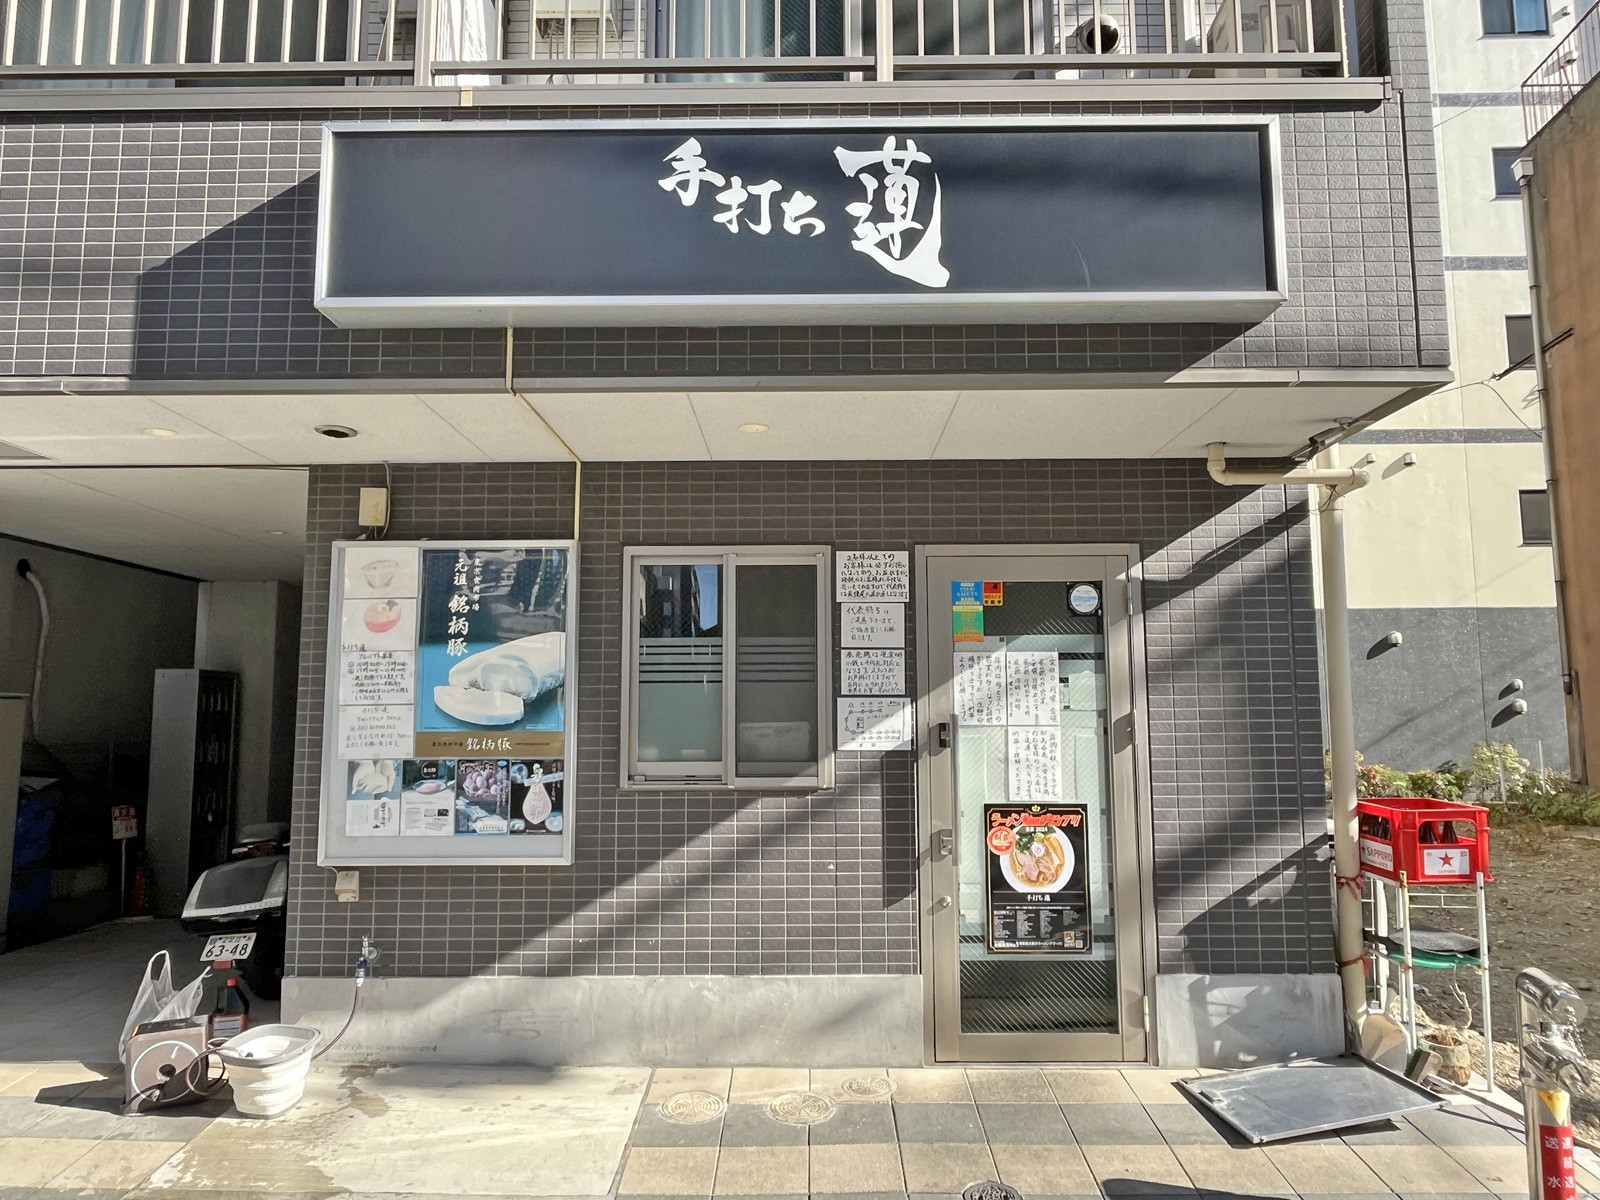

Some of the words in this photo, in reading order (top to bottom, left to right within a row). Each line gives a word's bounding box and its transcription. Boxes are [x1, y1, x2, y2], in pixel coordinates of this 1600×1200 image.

[453, 559, 469, 586] 元祖
[446, 594, 470, 657] 銘柄豚
[1366, 846, 1393, 862] SAPPORO
[205, 943, 248, 958] 63-48
